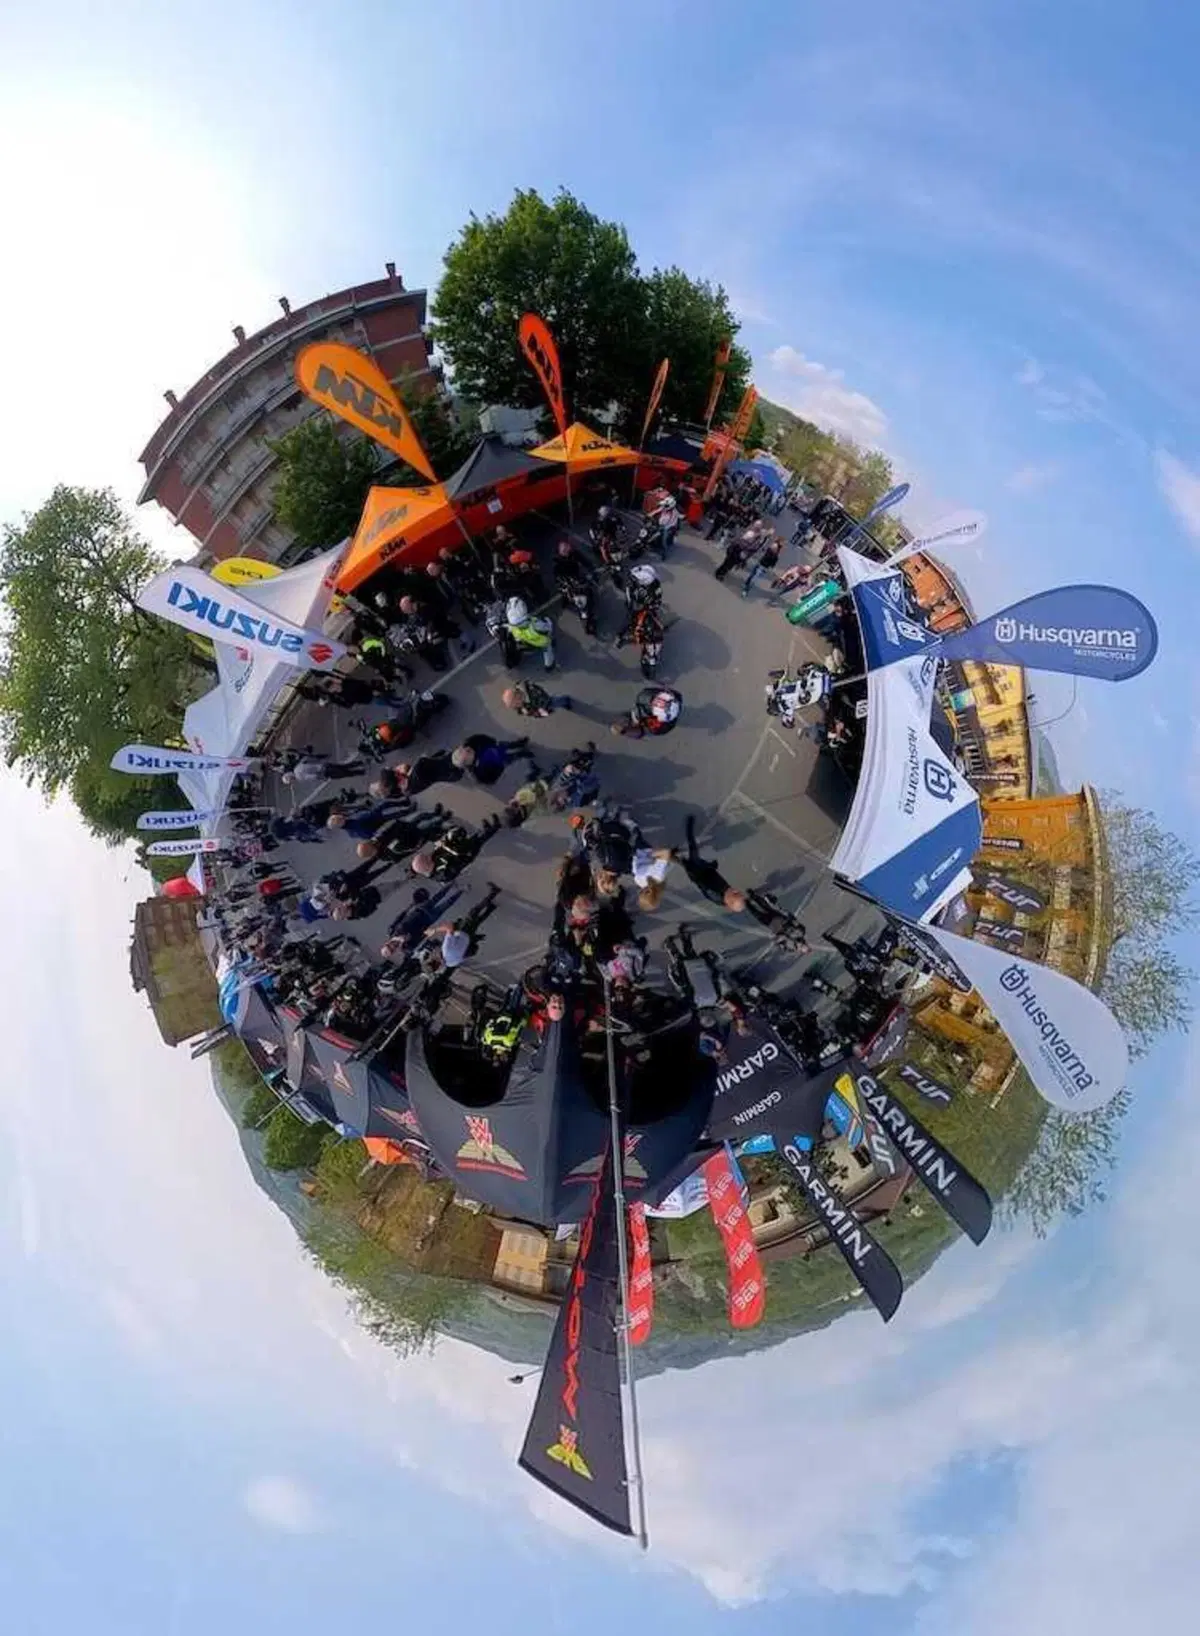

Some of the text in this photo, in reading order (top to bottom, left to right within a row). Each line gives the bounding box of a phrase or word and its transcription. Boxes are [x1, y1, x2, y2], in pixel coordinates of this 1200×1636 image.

[1019, 624, 1137, 648] Husqvarna
[903, 725, 920, 816] Husqvarna
[1016, 987, 1093, 1091] Husqvarna
[731, 1090, 782, 1126] GARMIN
[857, 1074, 957, 1193] GARMIN
[783, 1144, 872, 1262] GARMIN
